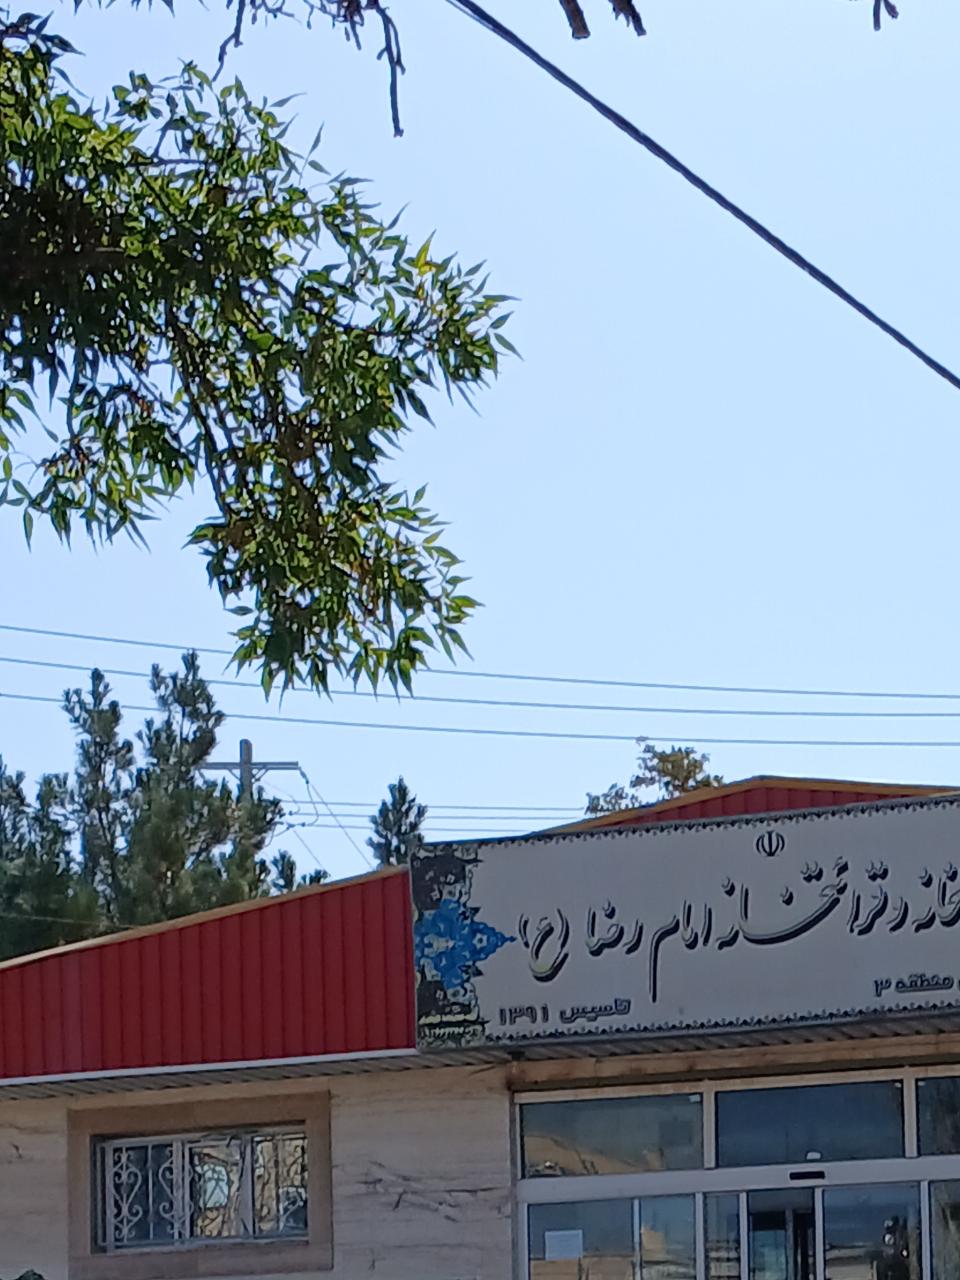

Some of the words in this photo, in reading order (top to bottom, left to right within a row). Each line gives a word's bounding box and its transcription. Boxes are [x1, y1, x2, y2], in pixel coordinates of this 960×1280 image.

[717, 856, 889, 946] قرائتخانه
[887, 896, 909, 933] و
[518, 908, 570, 983] (ع)
[585, 899, 644, 957] رضا
[650, 899, 712, 1003] امام
[873, 979, 892, 998] ۳
[894, 974, 954, 994] منطقه
[500, 1004, 550, 1027] ۱۳۹۱
[559, 998, 631, 1024] تاسیس
